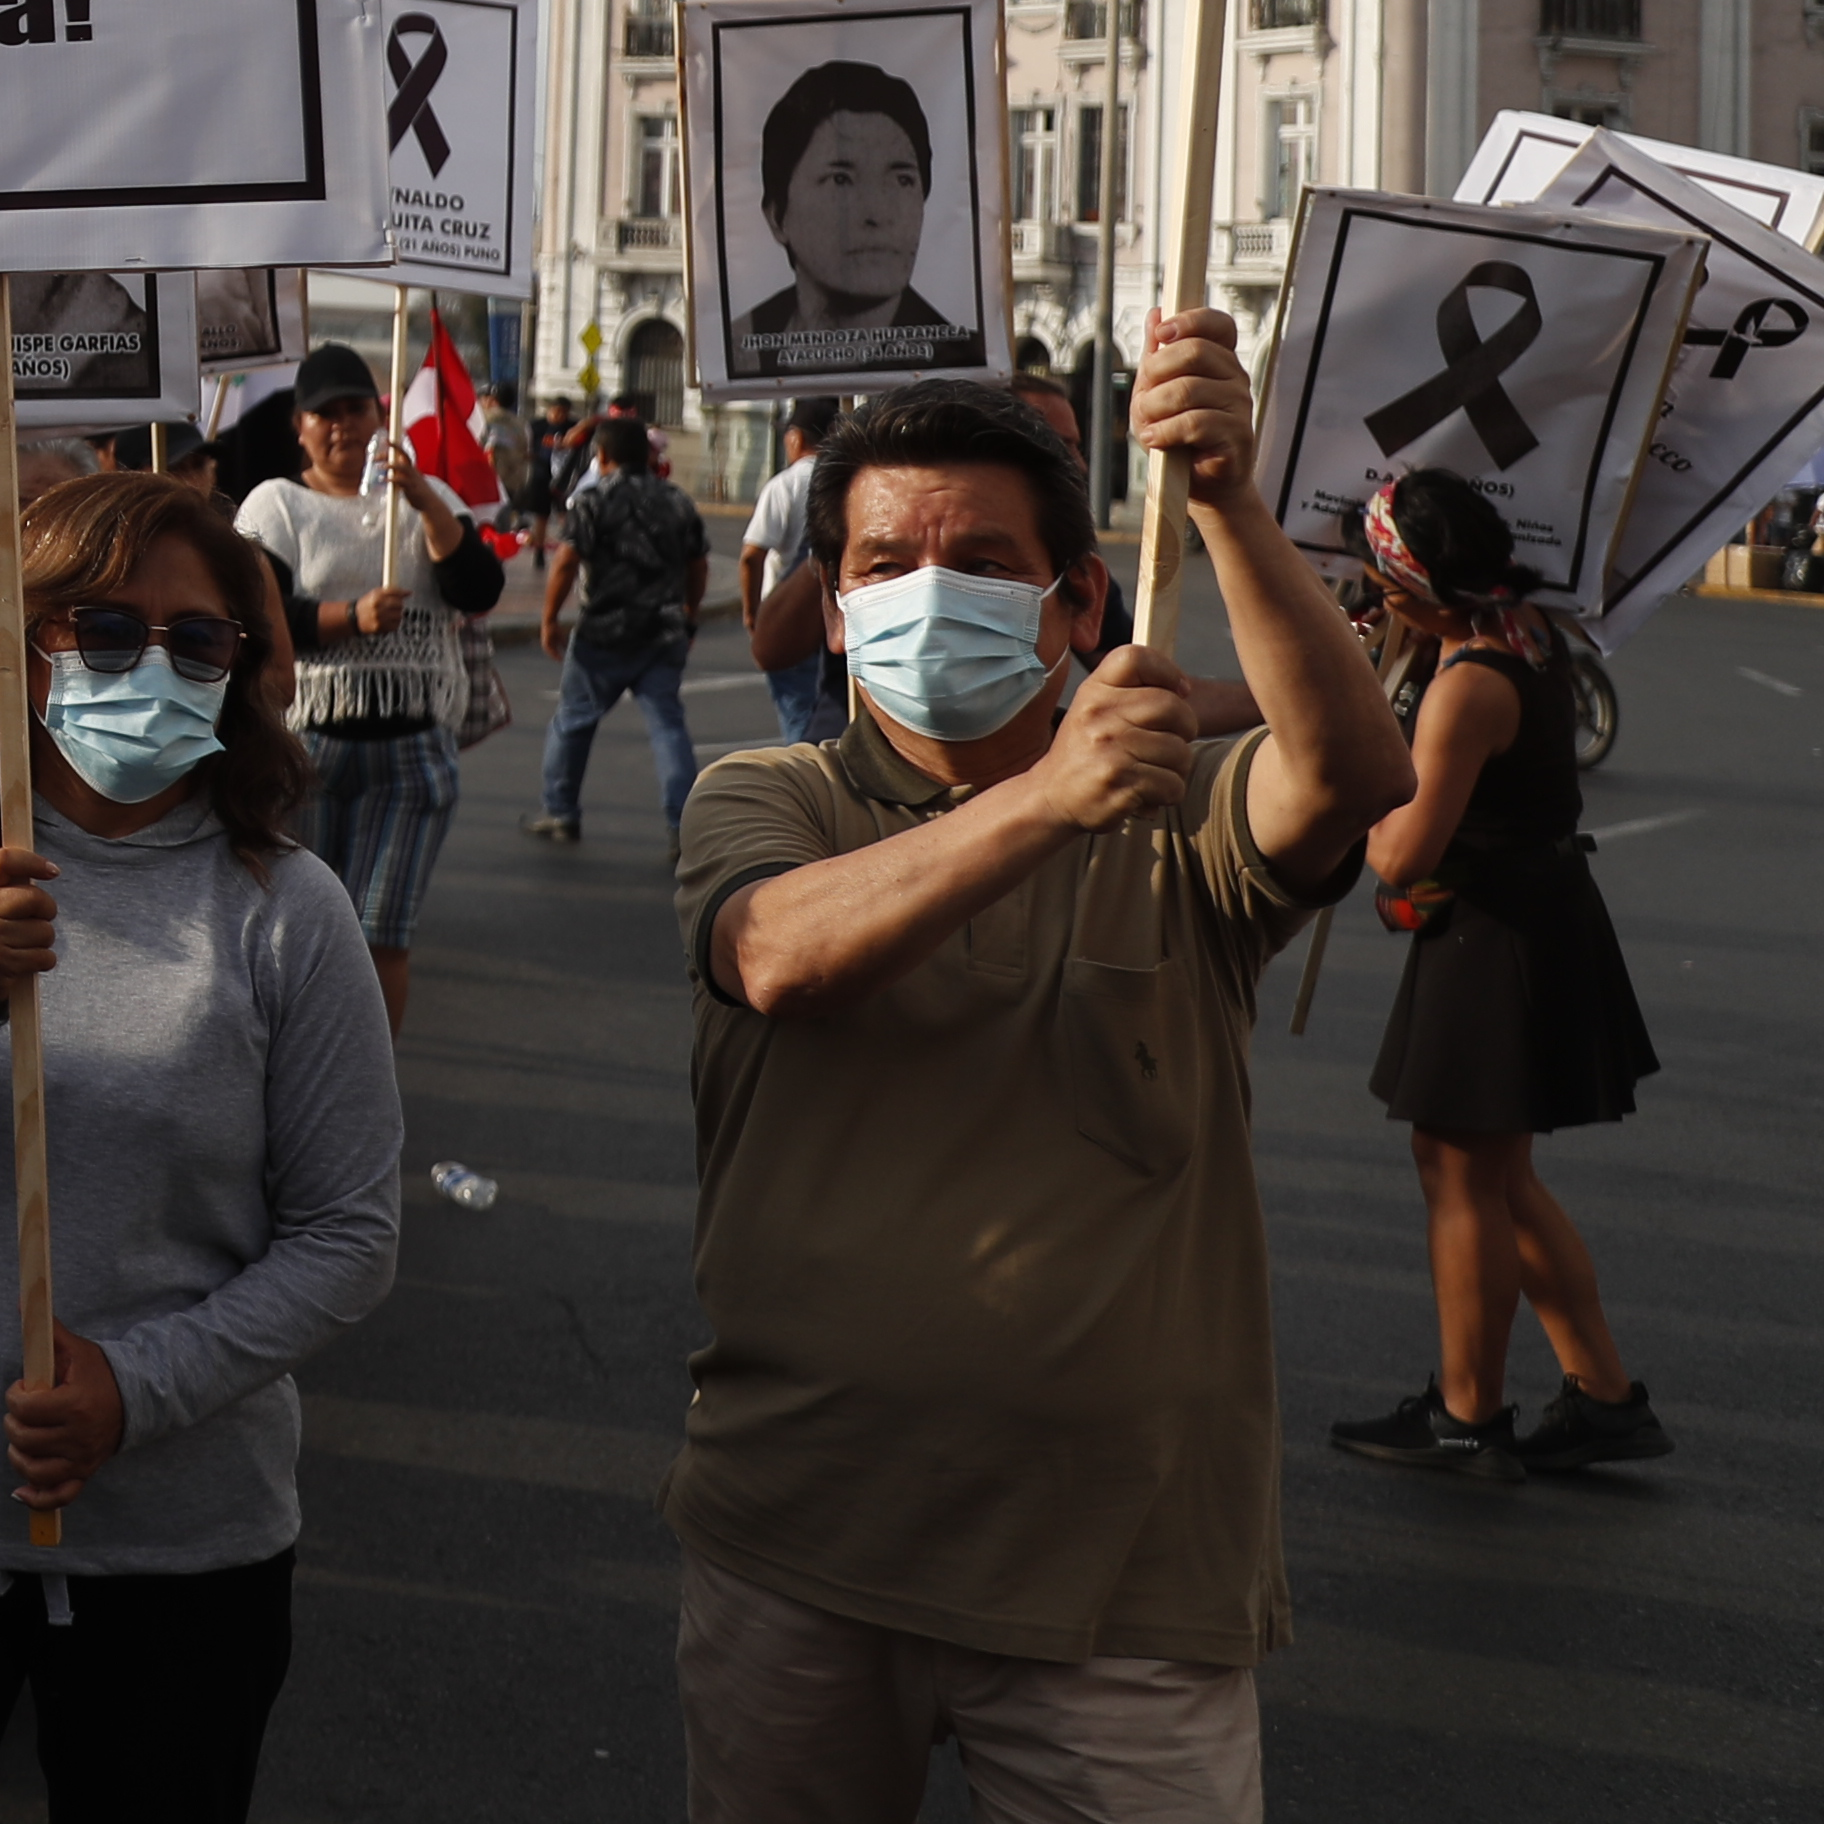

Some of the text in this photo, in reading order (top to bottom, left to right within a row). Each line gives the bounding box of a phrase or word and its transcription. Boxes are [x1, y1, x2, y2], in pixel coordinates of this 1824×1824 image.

[392, 186, 465, 212] NALDO
[440, 218, 491, 239] CRUZ
[464, 246, 500, 261] PUNO
[59, 332, 141, 354] GARFIAS
[742, 333, 788, 350] JHON
[789, 328, 868, 349] MENDOZA
